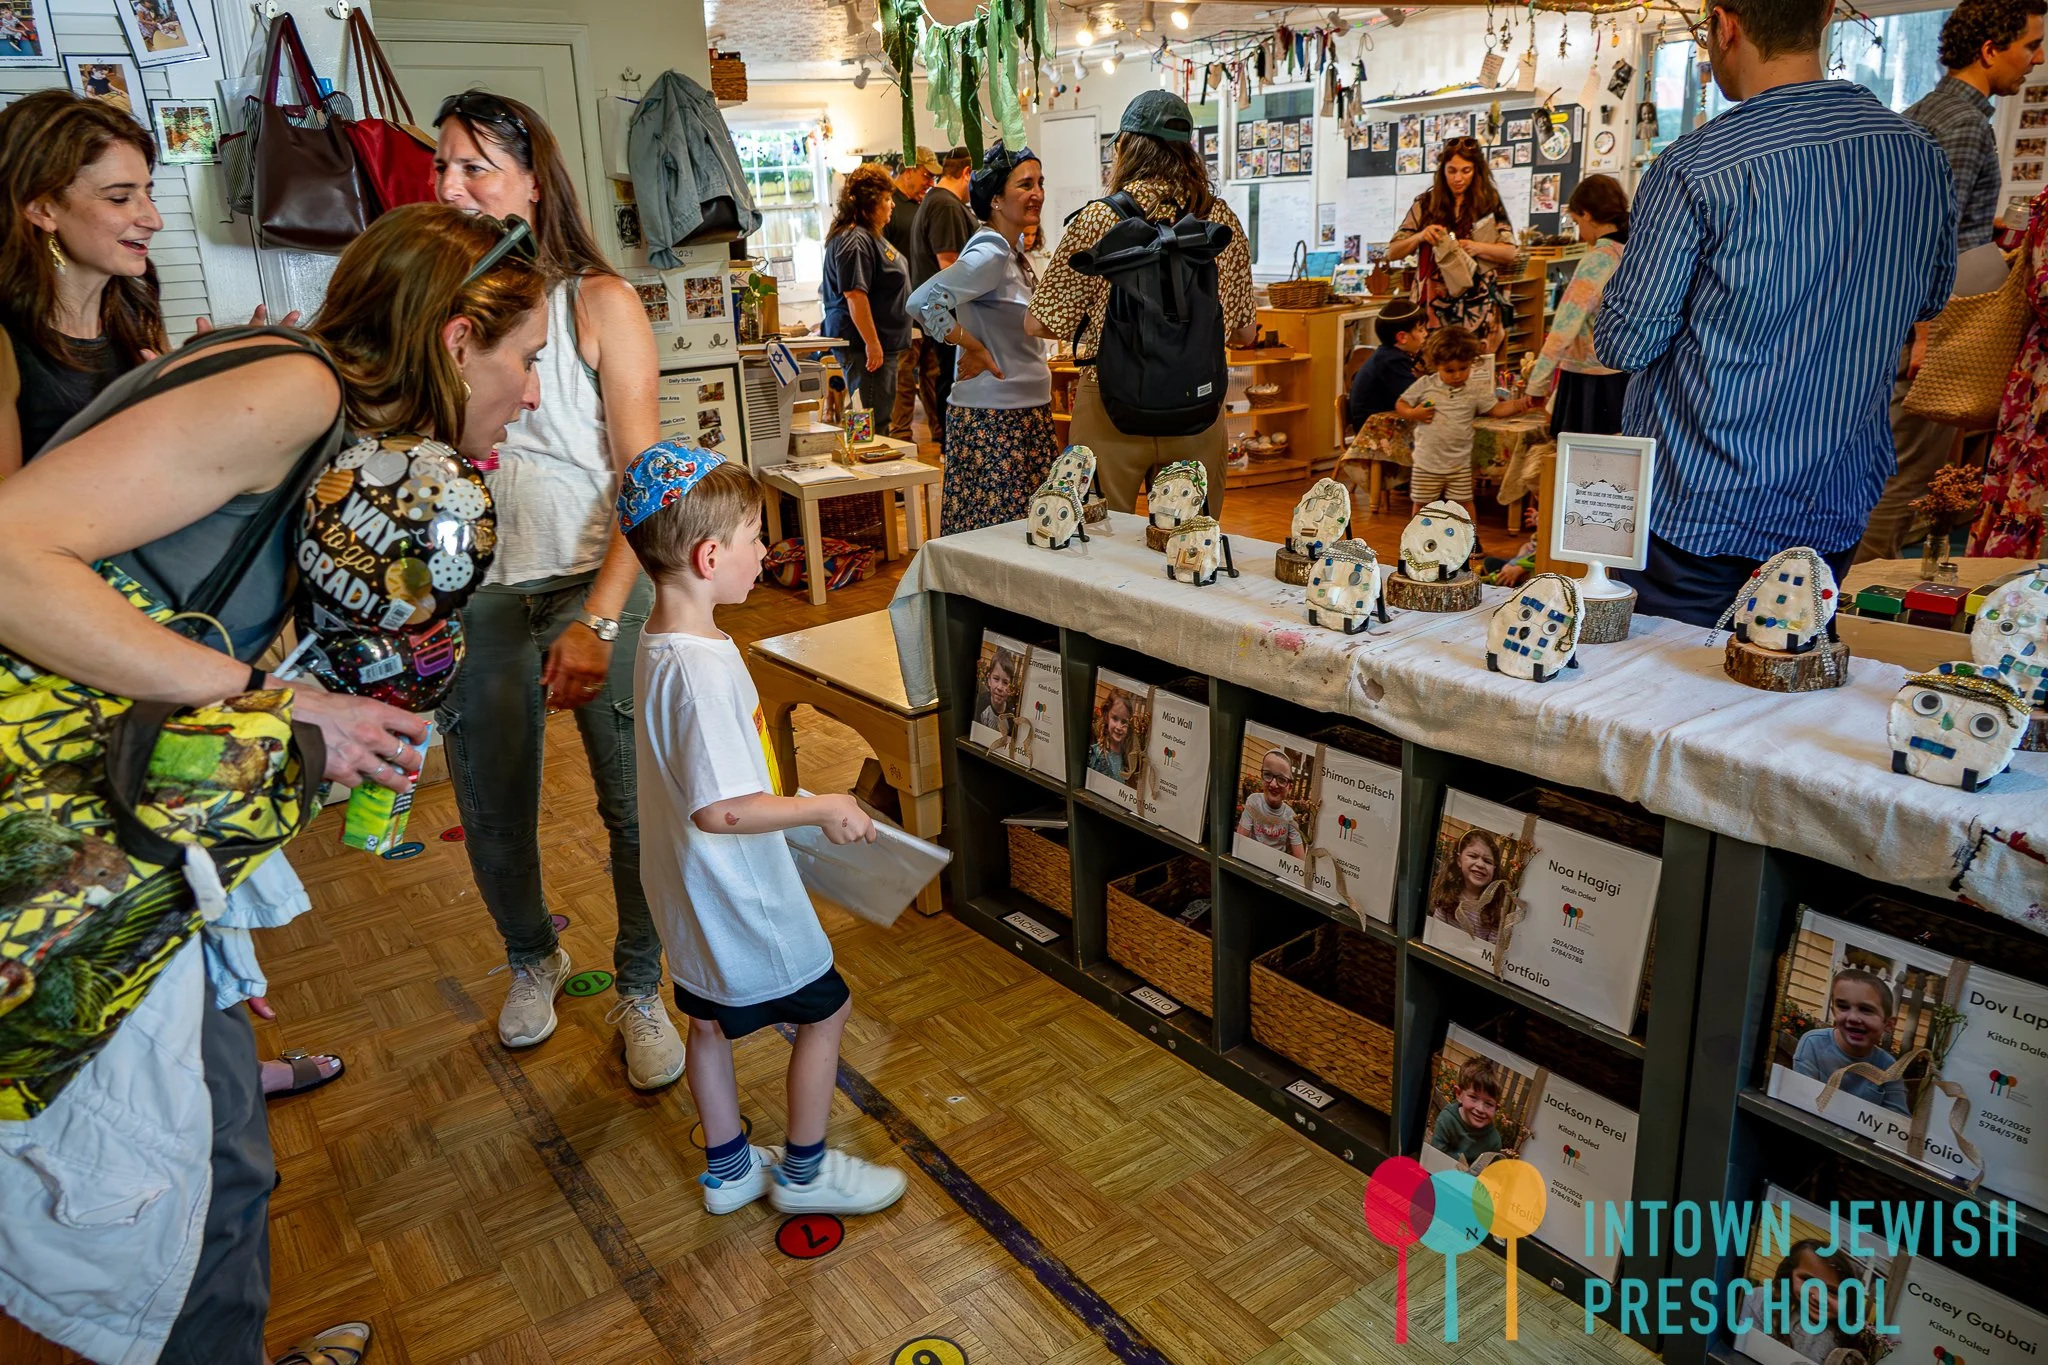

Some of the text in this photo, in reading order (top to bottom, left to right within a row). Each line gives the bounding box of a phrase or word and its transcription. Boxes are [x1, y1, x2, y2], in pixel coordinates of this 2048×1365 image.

[339, 491, 410, 555] WAY
[321, 522, 376, 575] to go
[299, 539, 380, 618] GRAD!
[1028, 658, 1051, 673] Emmett
[1038, 683, 1060, 695] Kitah Daled
[1162, 711, 1193, 731] Mia Wall
[1161, 731, 1186, 746] Kitah Daled
[1159, 778, 1178, 791] 2024/2025
[1321, 766, 1395, 801] Shimon Deitsch
[1118, 788, 1157, 814] My Pofolio
[1337, 794, 1371, 812] Kitah Daled
[1278, 858, 1332, 889] My Pofolio
[1548, 859, 1622, 897] Noa Hagigi
[1561, 884, 1597, 903] Kitah Daled
[1550, 946, 1583, 964] 5784/5785
[1552, 937, 1585, 956] 2024/2025
[571, 973, 607, 993] 10
[1139, 990, 1172, 1011] SHILO
[1969, 990, 2008, 1014] Dov
[1986, 1030, 2018, 1049] Kitah
[1291, 1082, 1322, 1104] KIRA
[1543, 1092, 1627, 1143] Jackson Perel
[1980, 1109, 2032, 1135] 2024/2025
[1558, 1122, 1600, 1151] Kitah Daled
[1857, 1110, 1964, 1164] My Pofolio
[1978, 1119, 2029, 1145] 5784/5785
[1550, 1187, 1581, 1209] 5784/5785
[1551, 1178, 1583, 1201] 2024/2025
[1907, 1282, 2038, 1355] Casey Gabbai
[1928, 1318, 1991, 1356] Kitah Daled
